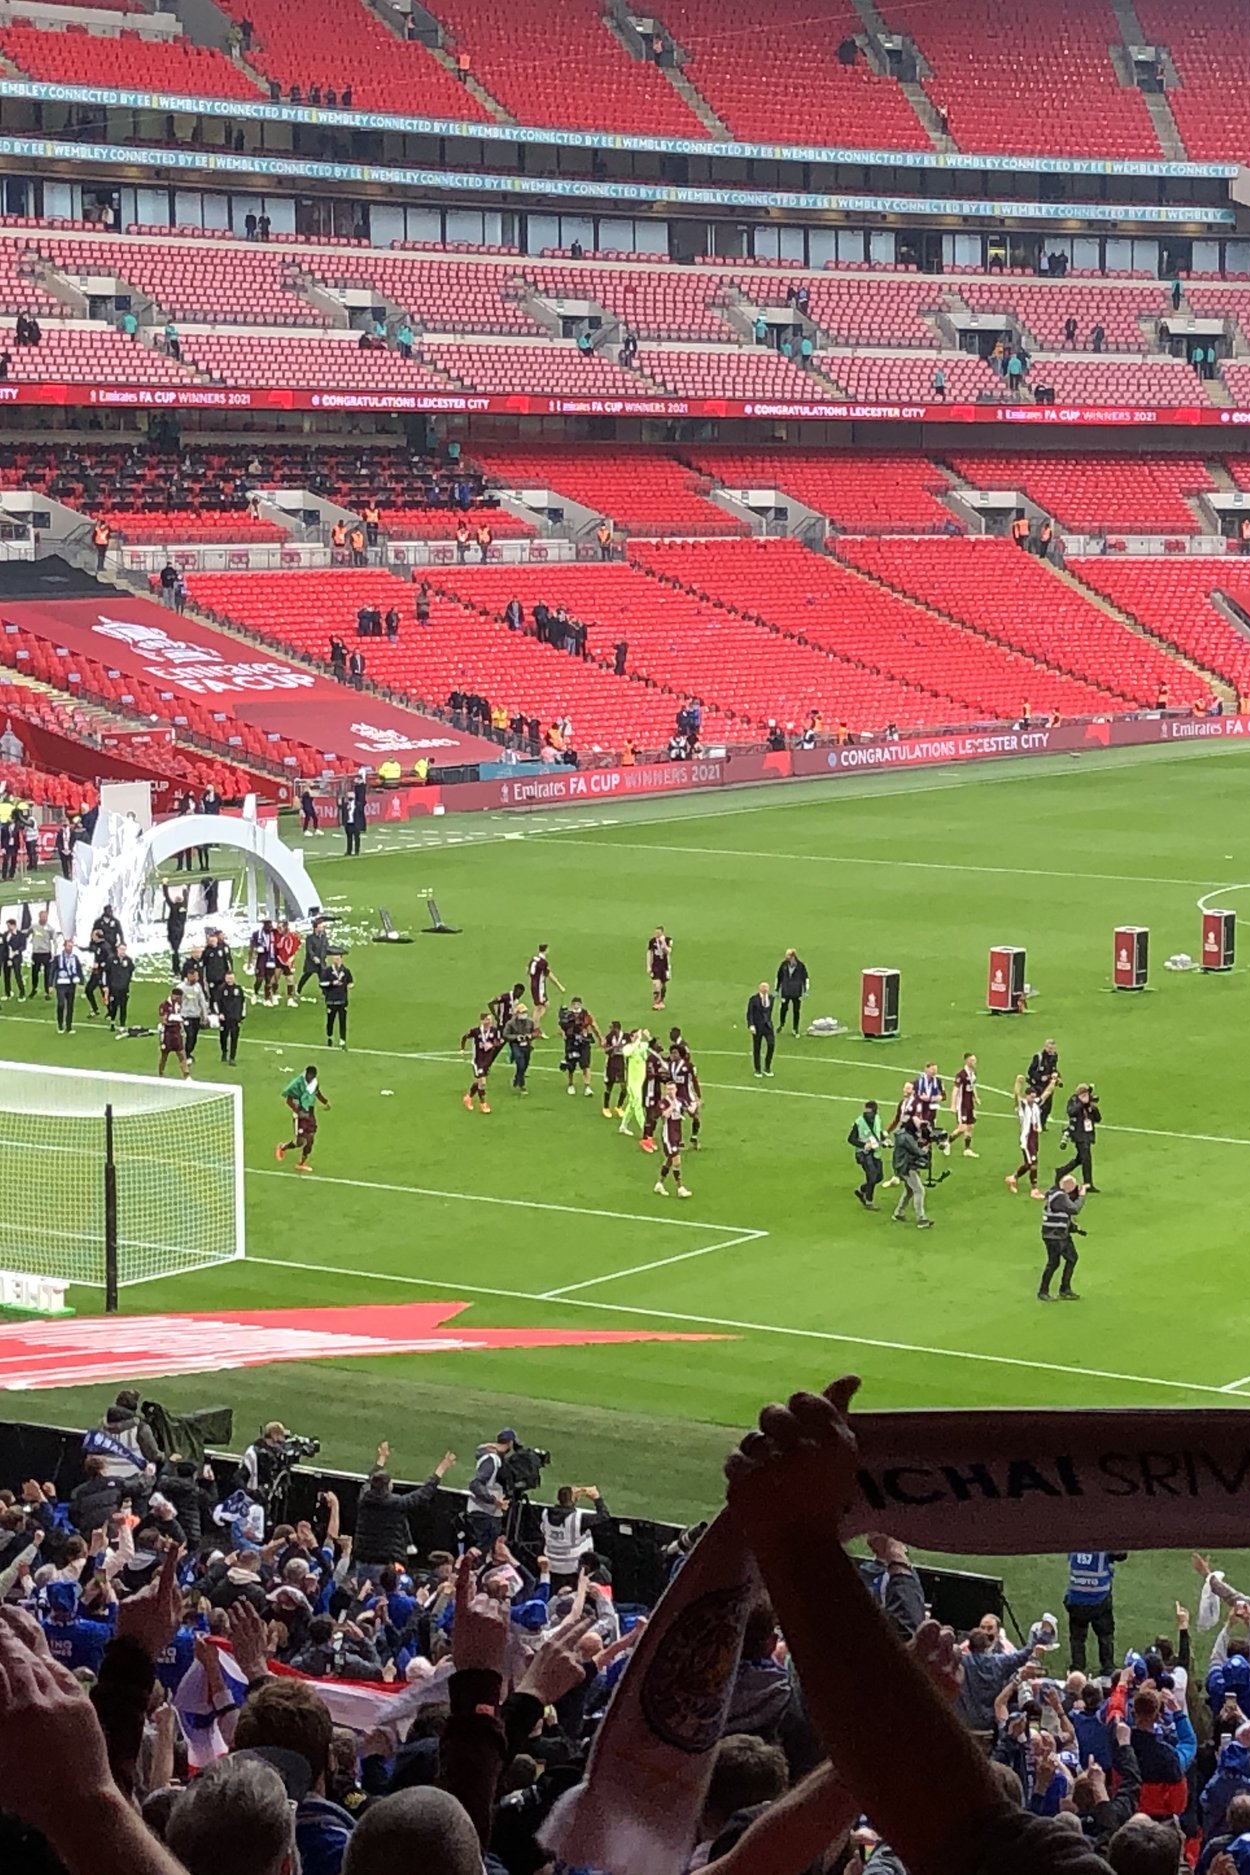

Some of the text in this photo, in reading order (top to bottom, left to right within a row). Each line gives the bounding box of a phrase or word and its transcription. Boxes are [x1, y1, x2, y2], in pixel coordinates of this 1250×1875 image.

[48, 87, 116, 103] CONNECTED
[120, 94, 136, 105] BY
[160, 97, 212, 112] WEMBLEY
[214, 102, 278, 118] CONNECTED
[282, 108, 296, 119] BY
[317, 111, 368, 126] WEMBLEY
[370, 116, 431, 132] CONNECTED
[434, 122, 447, 133] BY
[468, 125, 518, 139] WEMBLEY
[520, 129, 582, 144] CONNECTED
[585, 134, 599, 145] BY
[14, 142, 30, 153] BY
[54, 145, 108, 159] WEMBLEY
[110, 149, 175, 165] CONNECTED
[178, 155, 192, 166] BY
[622, 137, 674, 150] WEMBLEY
[676, 140, 742, 155] CONNECTED
[744, 145, 758, 156] BY
[782, 147, 835, 160] WEMBLEY
[837, 150, 902, 164] CONNECTED
[907, 154, 921, 165] BY
[946, 156, 1000, 168] WEMBLEY
[1002, 158, 1070, 171] CONNECTED
[1074, 161, 1088, 171] BY
[216, 158, 267, 172] WEMBLEY
[269, 162, 331, 177] CONNECTED
[334, 167, 348, 179] BY
[1113, 162, 1238, 176] WEMBLEY CONNECTED
[370, 170, 419, 184] WEMBLEY
[420, 173, 482, 188] CONNECTED
[485, 178, 499, 189] BY
[520, 180, 570, 193] WEMBLEY
[572, 183, 637, 197] CONNECTED
[640, 187, 654, 198] BY
[678, 189, 731, 202] WEMBLEY
[732, 192, 796, 205] CONNECTED
[800, 195, 814, 206] BY
[838, 197, 891, 210] WEMBLEY
[892, 200, 960, 213] CONNECTED
[963, 202, 977, 214] BY
[1002, 204, 1056, 216] WEMBLEY
[1058, 205, 1124, 218] CONNECTED
[1128, 207, 1143, 218] BY
[1168, 208, 1222, 220] WEMBLEY
[99, 391, 137, 402] Emirates
[139, 392, 153, 402] FA
[154, 392, 176, 402] CUP
[228, 394, 250, 404] 2021
[322, 395, 490, 409] CONGRATULATIONS LEICESTER CITY
[592, 402, 604, 412] FA
[605, 402, 622, 412] CUP
[668, 403, 688, 413] 2021
[754, 405, 926, 417] CONGRATULATIONS LEICESTER CITY
[1044, 410, 1058, 420] FA
[1059, 410, 1080, 420] CUP
[1134, 411, 1156, 421] 2021
[143, 662, 292, 680] Emirates
[175, 673, 316, 693] FA CUP
[1172, 721, 1221, 738] Emirates
[1225, 719, 1244, 734] FA
[840, 732, 1050, 767] CONGRATULATIONS LEICESTER CITY
[514, 764, 721, 801] Emirates FA CUP WINNERS 2021
[364, 801, 380, 816] 021
[857, 1456, 1083, 1510] ICHAI
